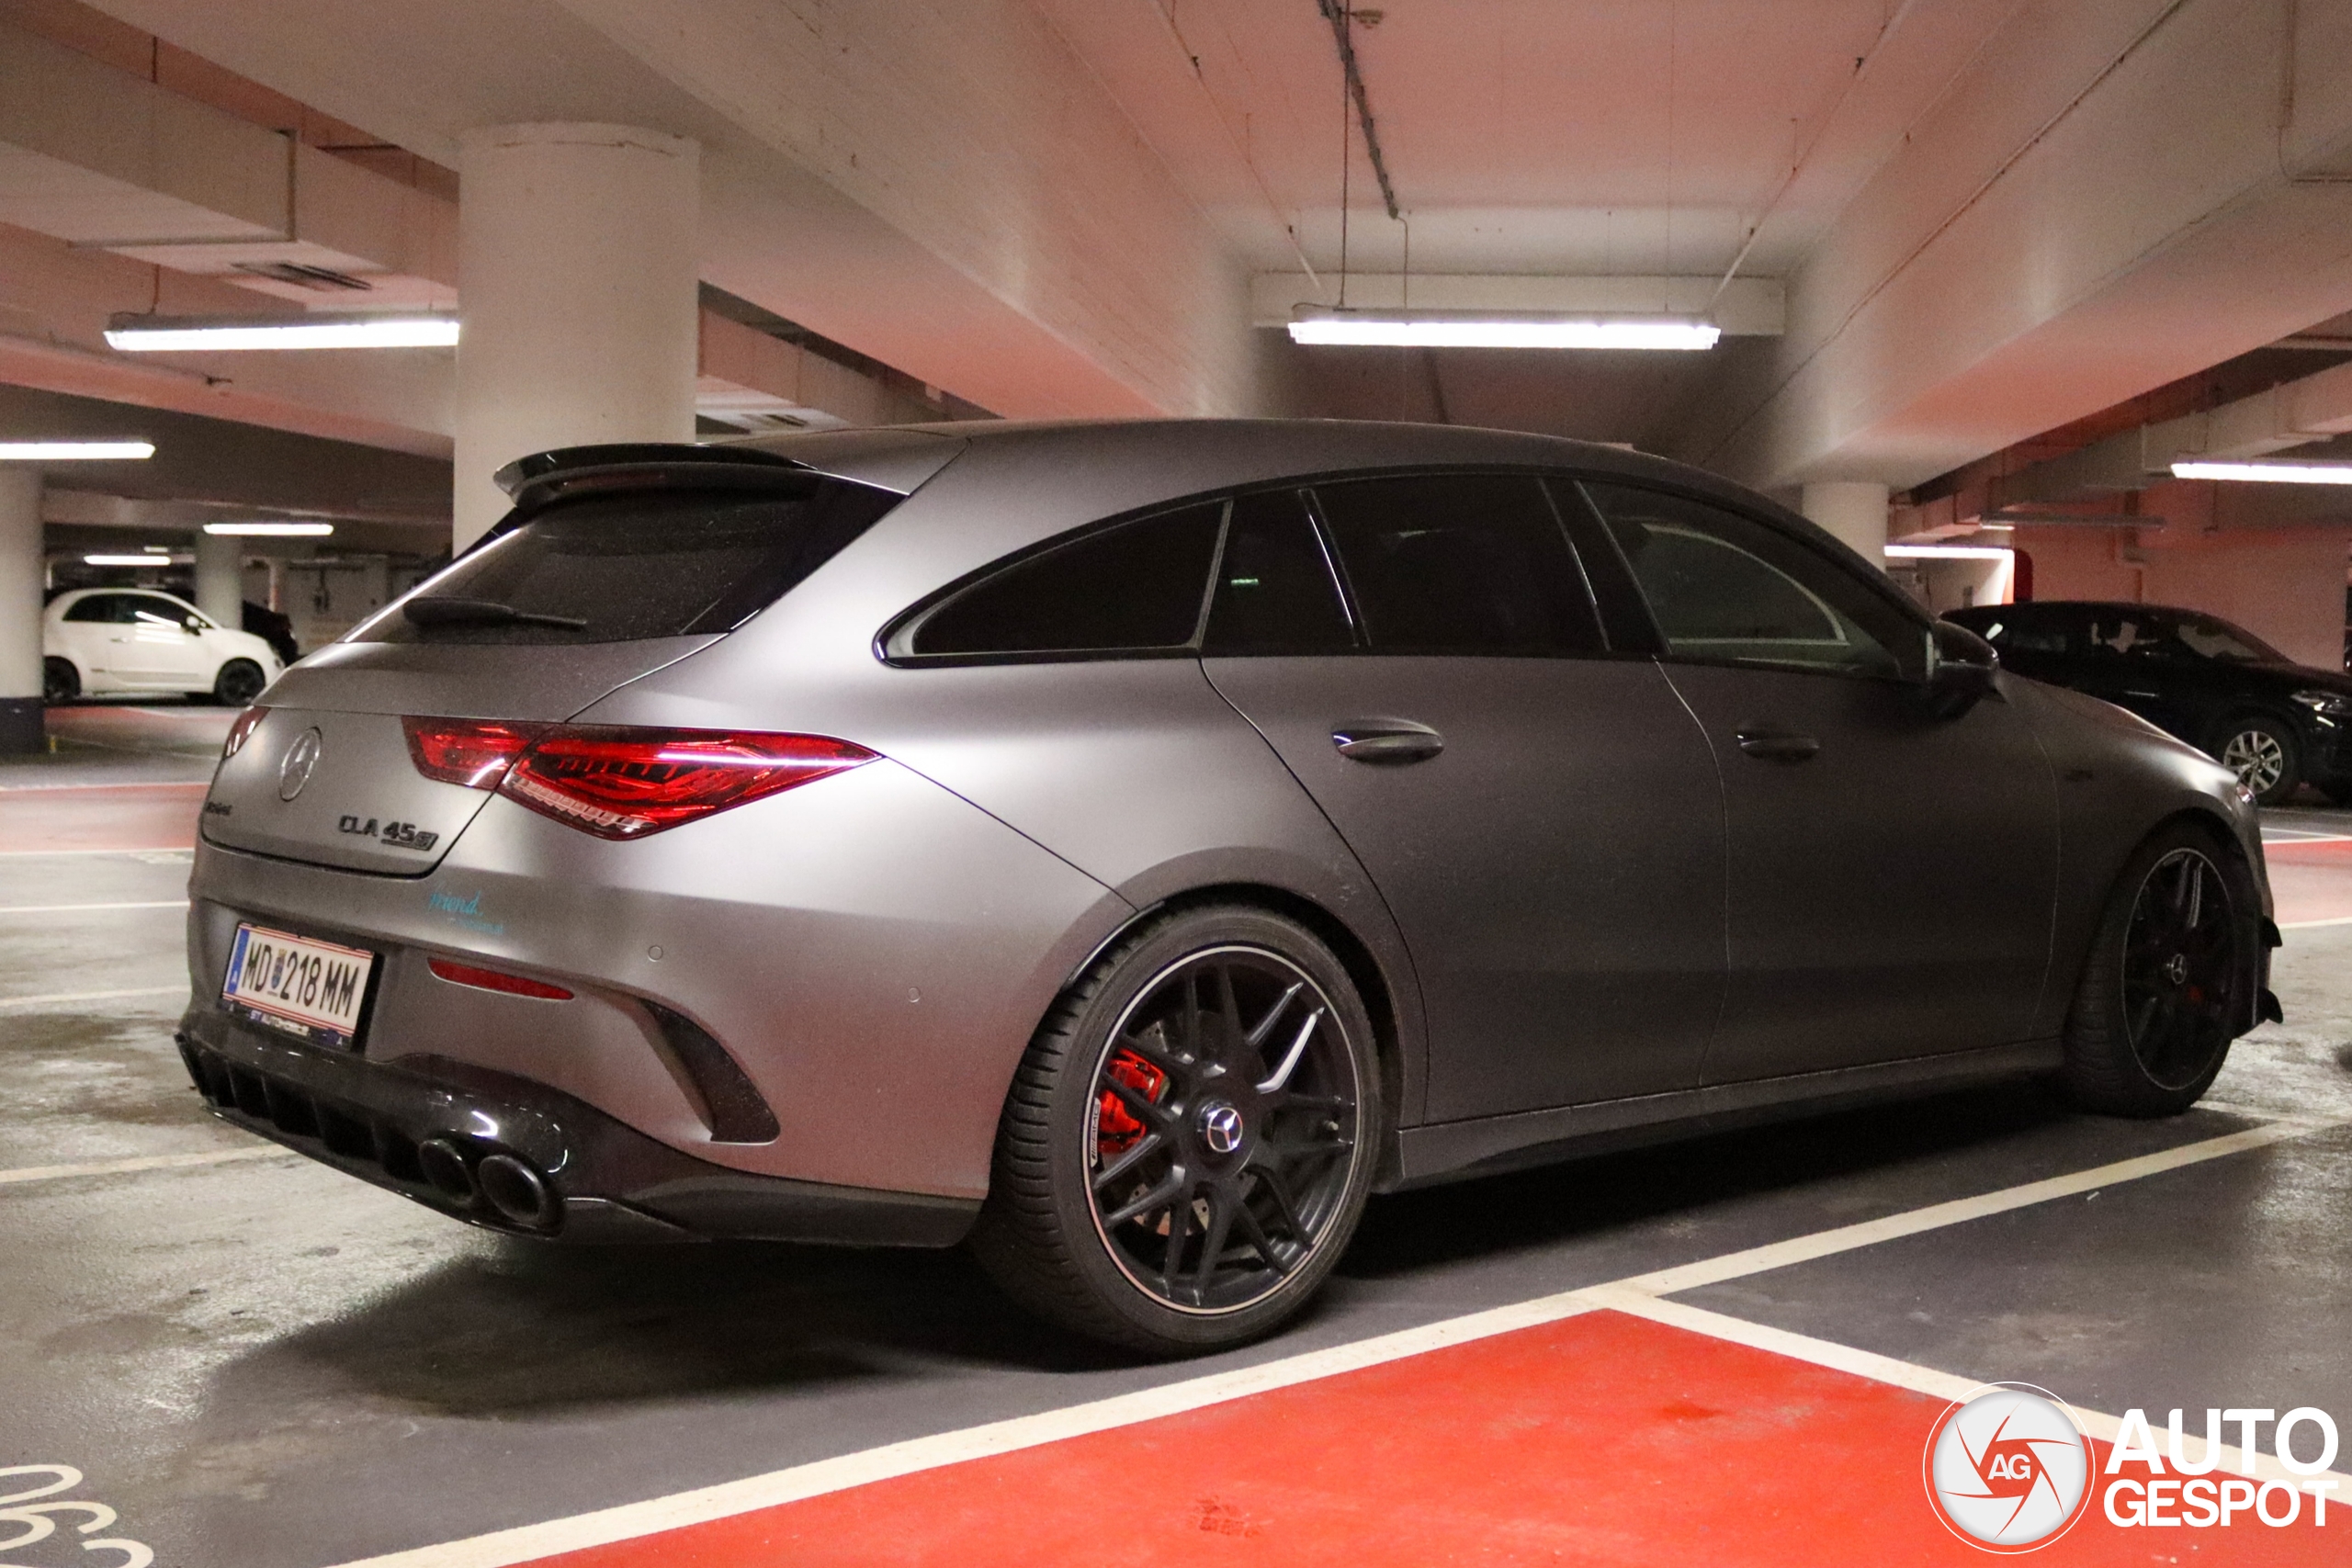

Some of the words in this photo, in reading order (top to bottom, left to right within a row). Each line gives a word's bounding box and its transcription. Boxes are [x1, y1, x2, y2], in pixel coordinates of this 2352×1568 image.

[338, 815, 379, 838] CLA
[231, 970, 239, 985] A
[241, 942, 273, 993] MD
